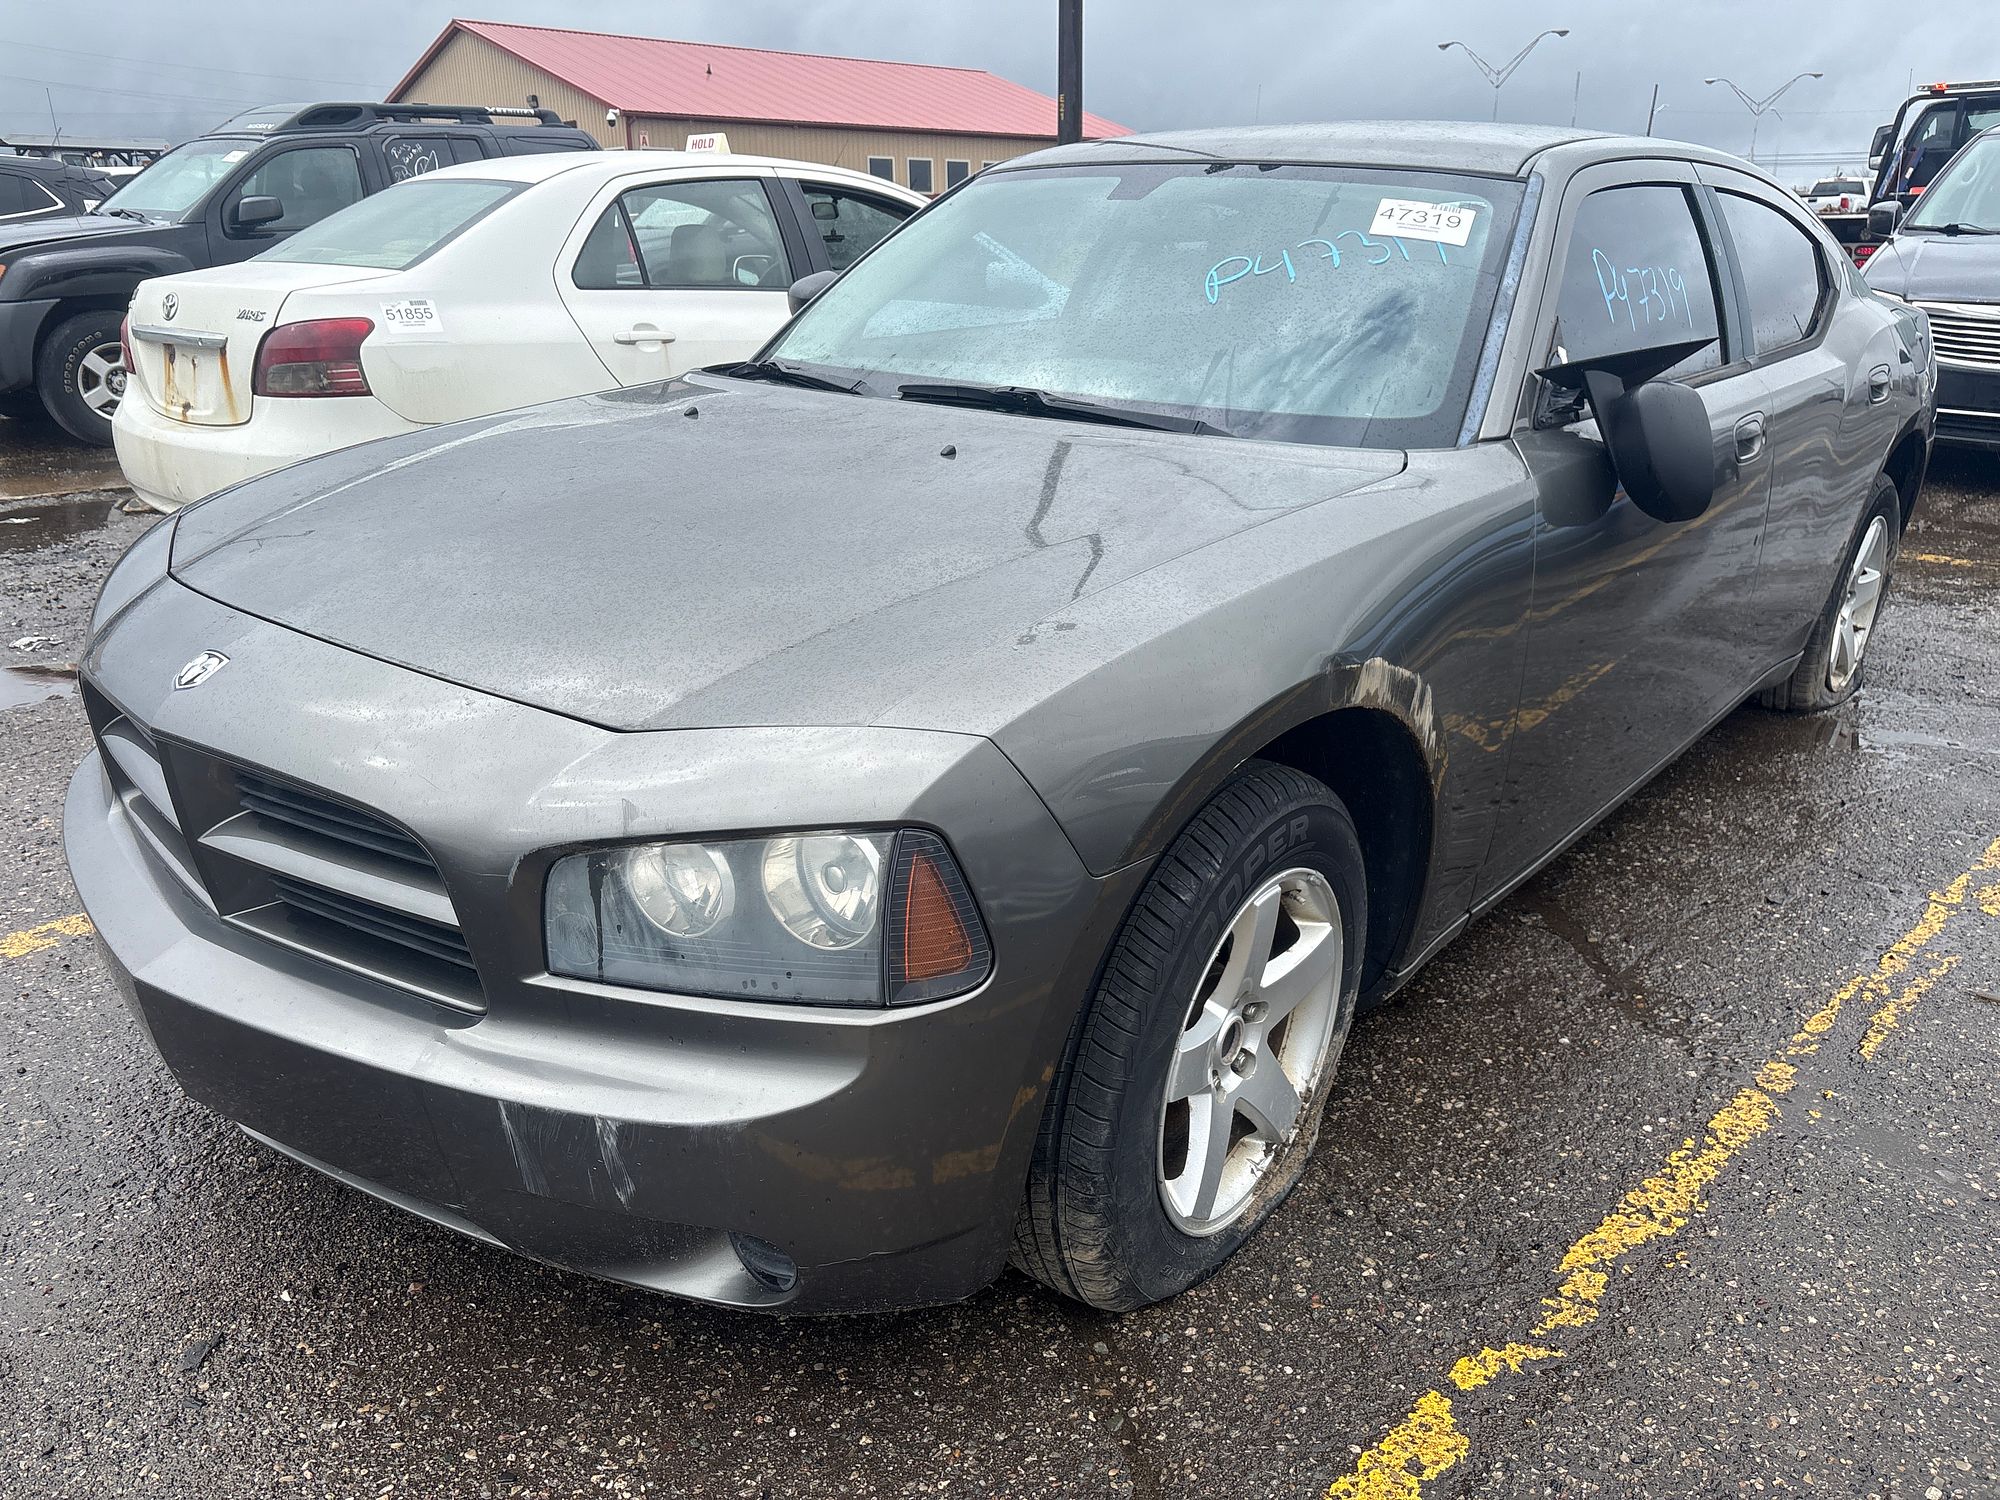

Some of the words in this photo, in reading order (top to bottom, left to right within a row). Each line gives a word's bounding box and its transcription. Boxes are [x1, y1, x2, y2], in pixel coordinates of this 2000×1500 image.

[691, 137, 715, 150] HOLD
[1380, 207, 1462, 229] 47319
[1592, 248, 1692, 332] P47319
[385, 307, 433, 321] 51855
